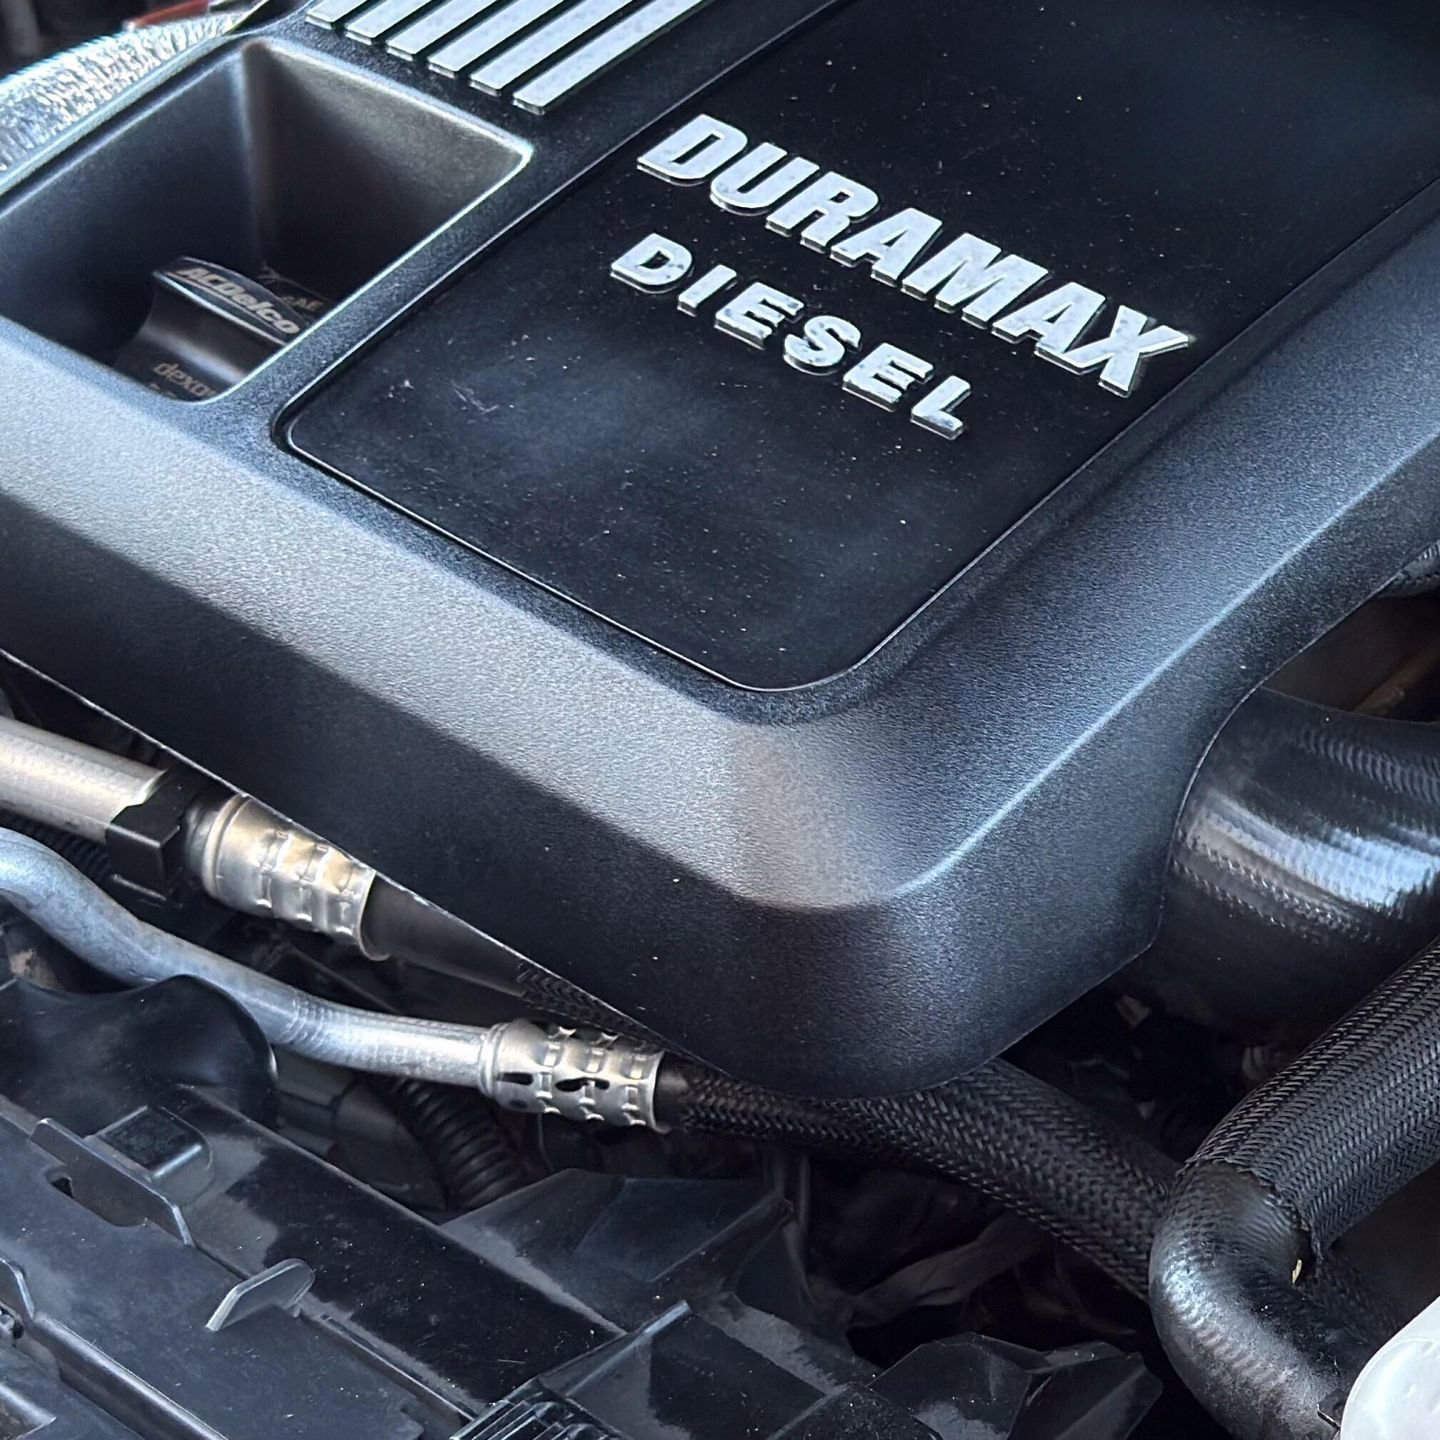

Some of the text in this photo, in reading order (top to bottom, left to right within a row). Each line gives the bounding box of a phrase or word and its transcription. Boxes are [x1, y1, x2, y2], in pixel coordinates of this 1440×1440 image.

[177, 267, 301, 335] ACDelco
[609, 233, 975, 440] DIESEL
[634, 113, 1195, 397] DURAMAX
